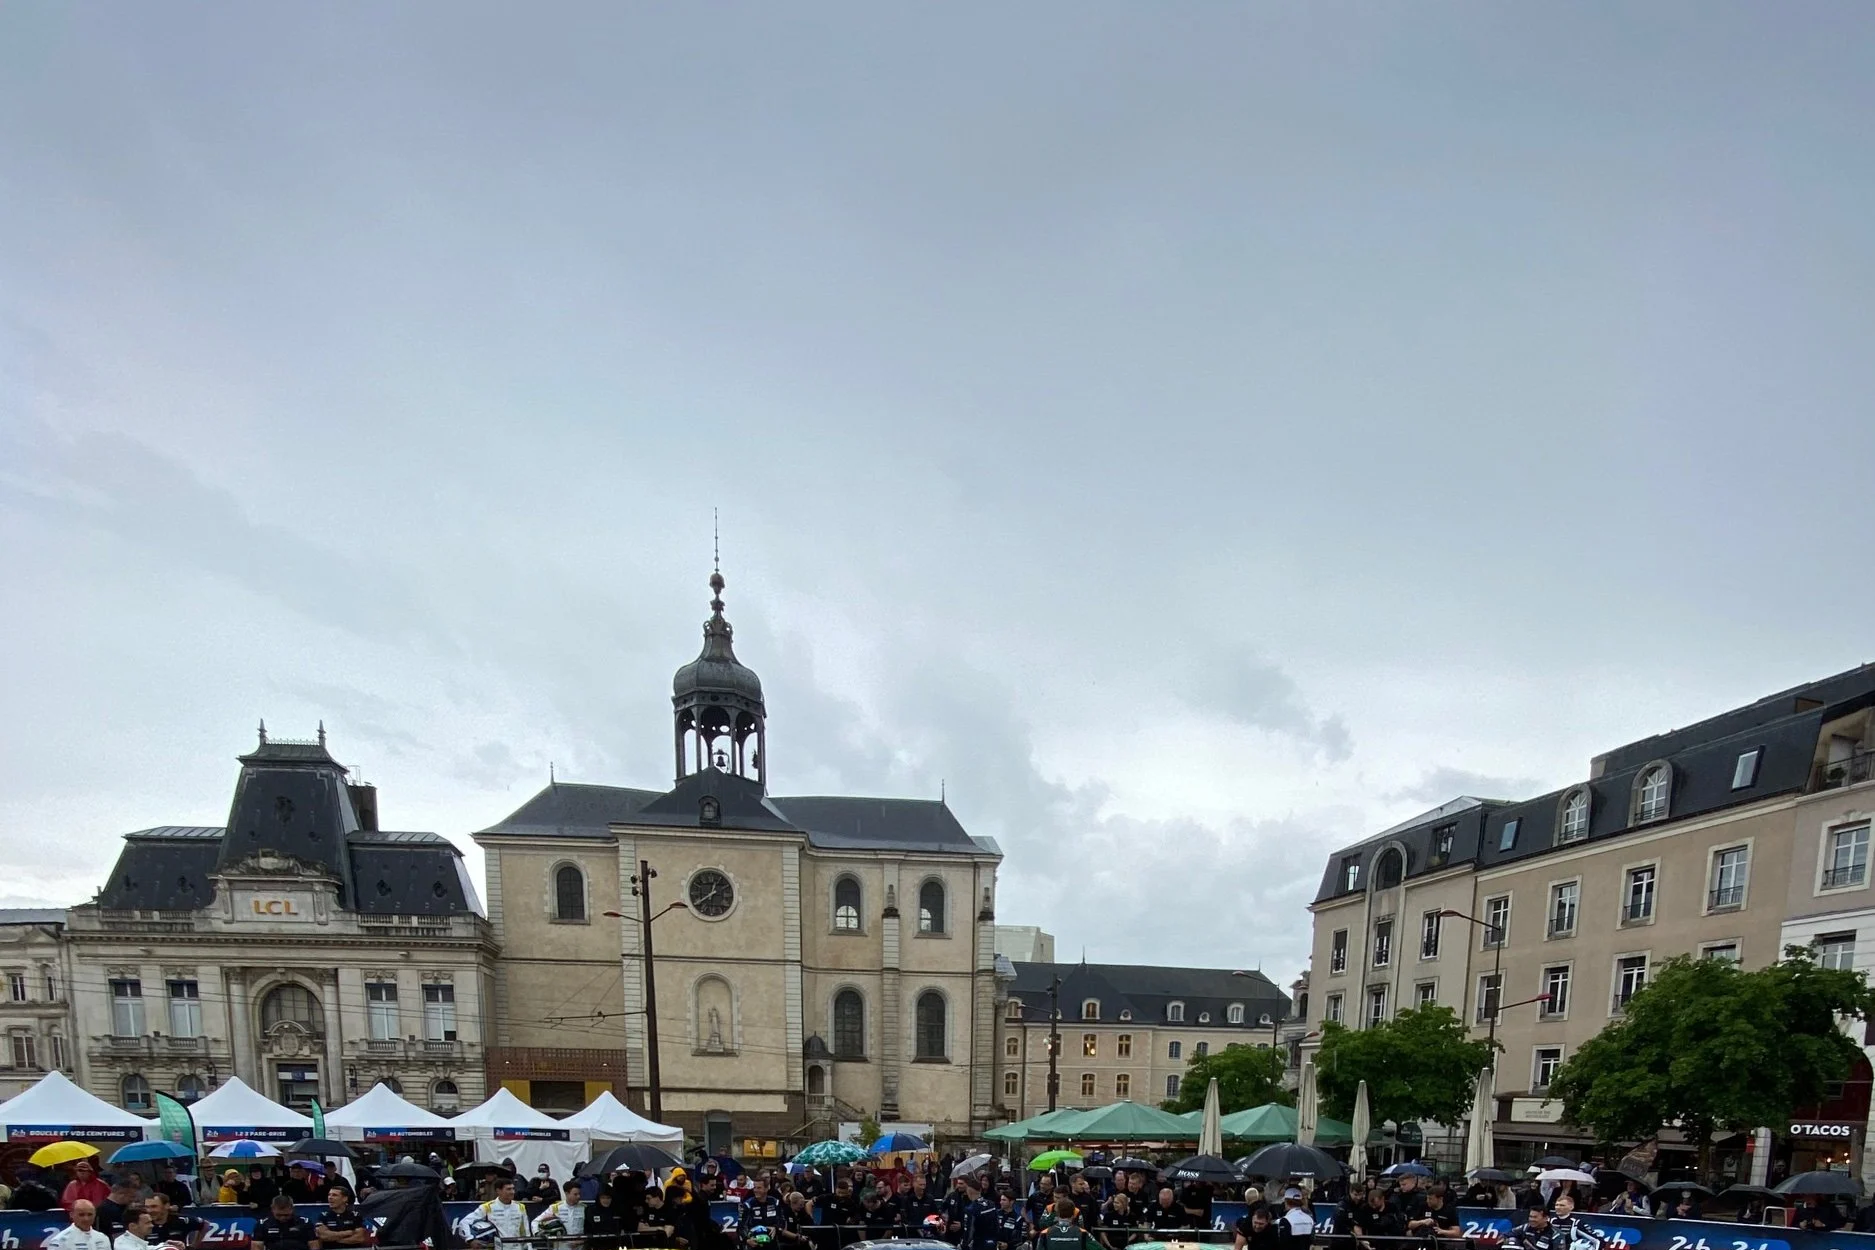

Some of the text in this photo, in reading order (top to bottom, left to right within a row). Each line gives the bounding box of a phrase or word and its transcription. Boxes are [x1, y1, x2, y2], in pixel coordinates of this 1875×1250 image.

[253, 900, 298, 915] LCL
[1790, 1124, 1850, 1136] O'TACOS
[202, 1222, 245, 1242] 24h
[1462, 1221, 1498, 1239] 24h
